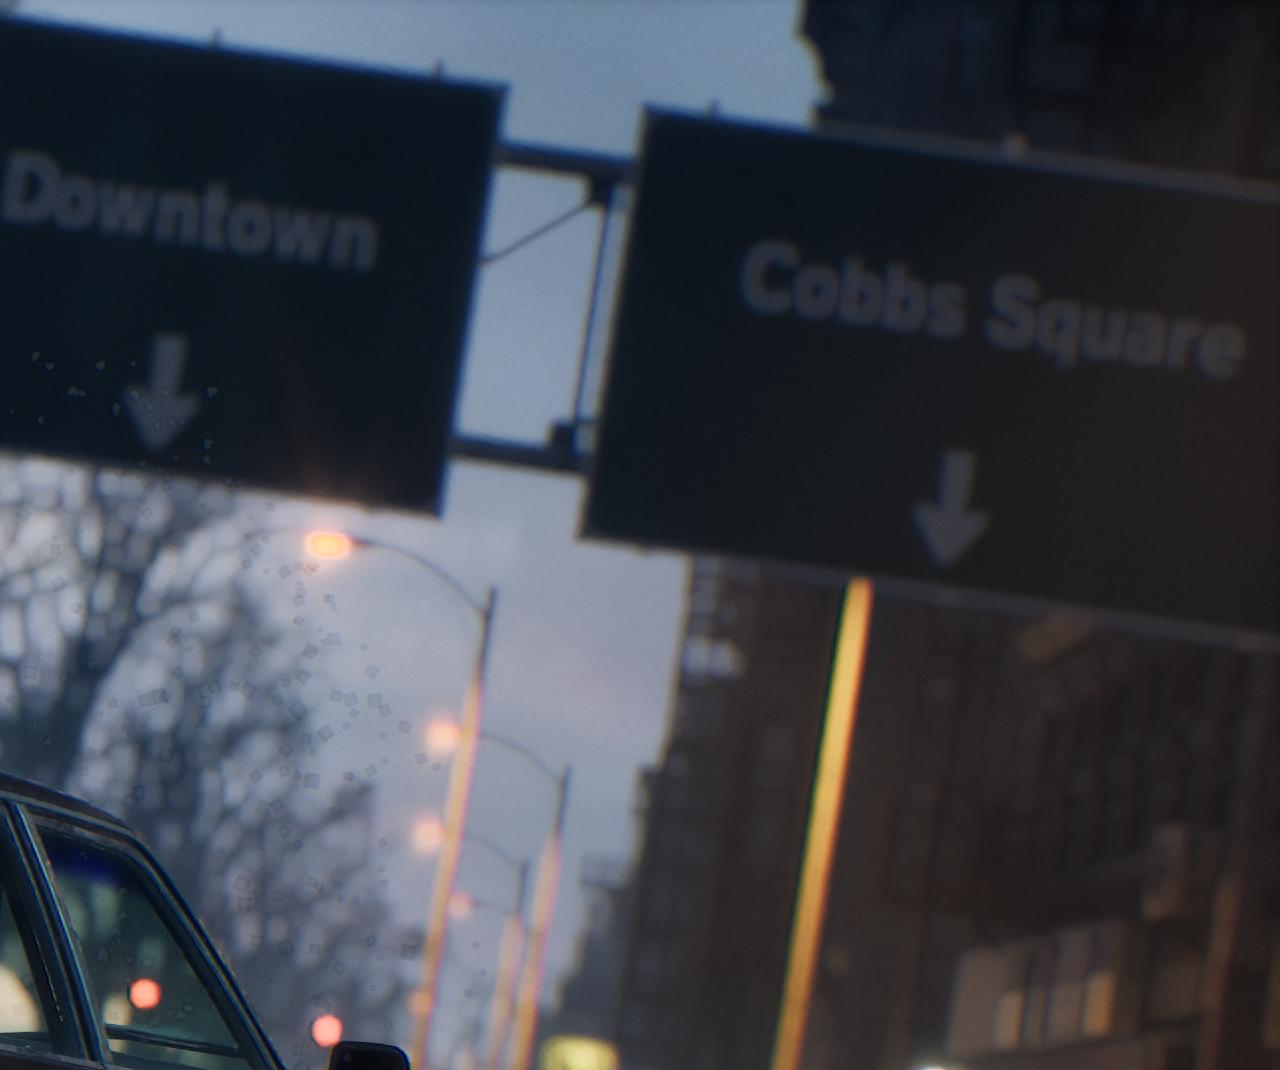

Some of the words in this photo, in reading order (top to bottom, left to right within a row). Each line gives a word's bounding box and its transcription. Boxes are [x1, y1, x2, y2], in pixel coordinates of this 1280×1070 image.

[0, 148, 379, 273] Downtown
[742, 238, 967, 340] Cobbs
[985, 273, 1247, 379] Square
